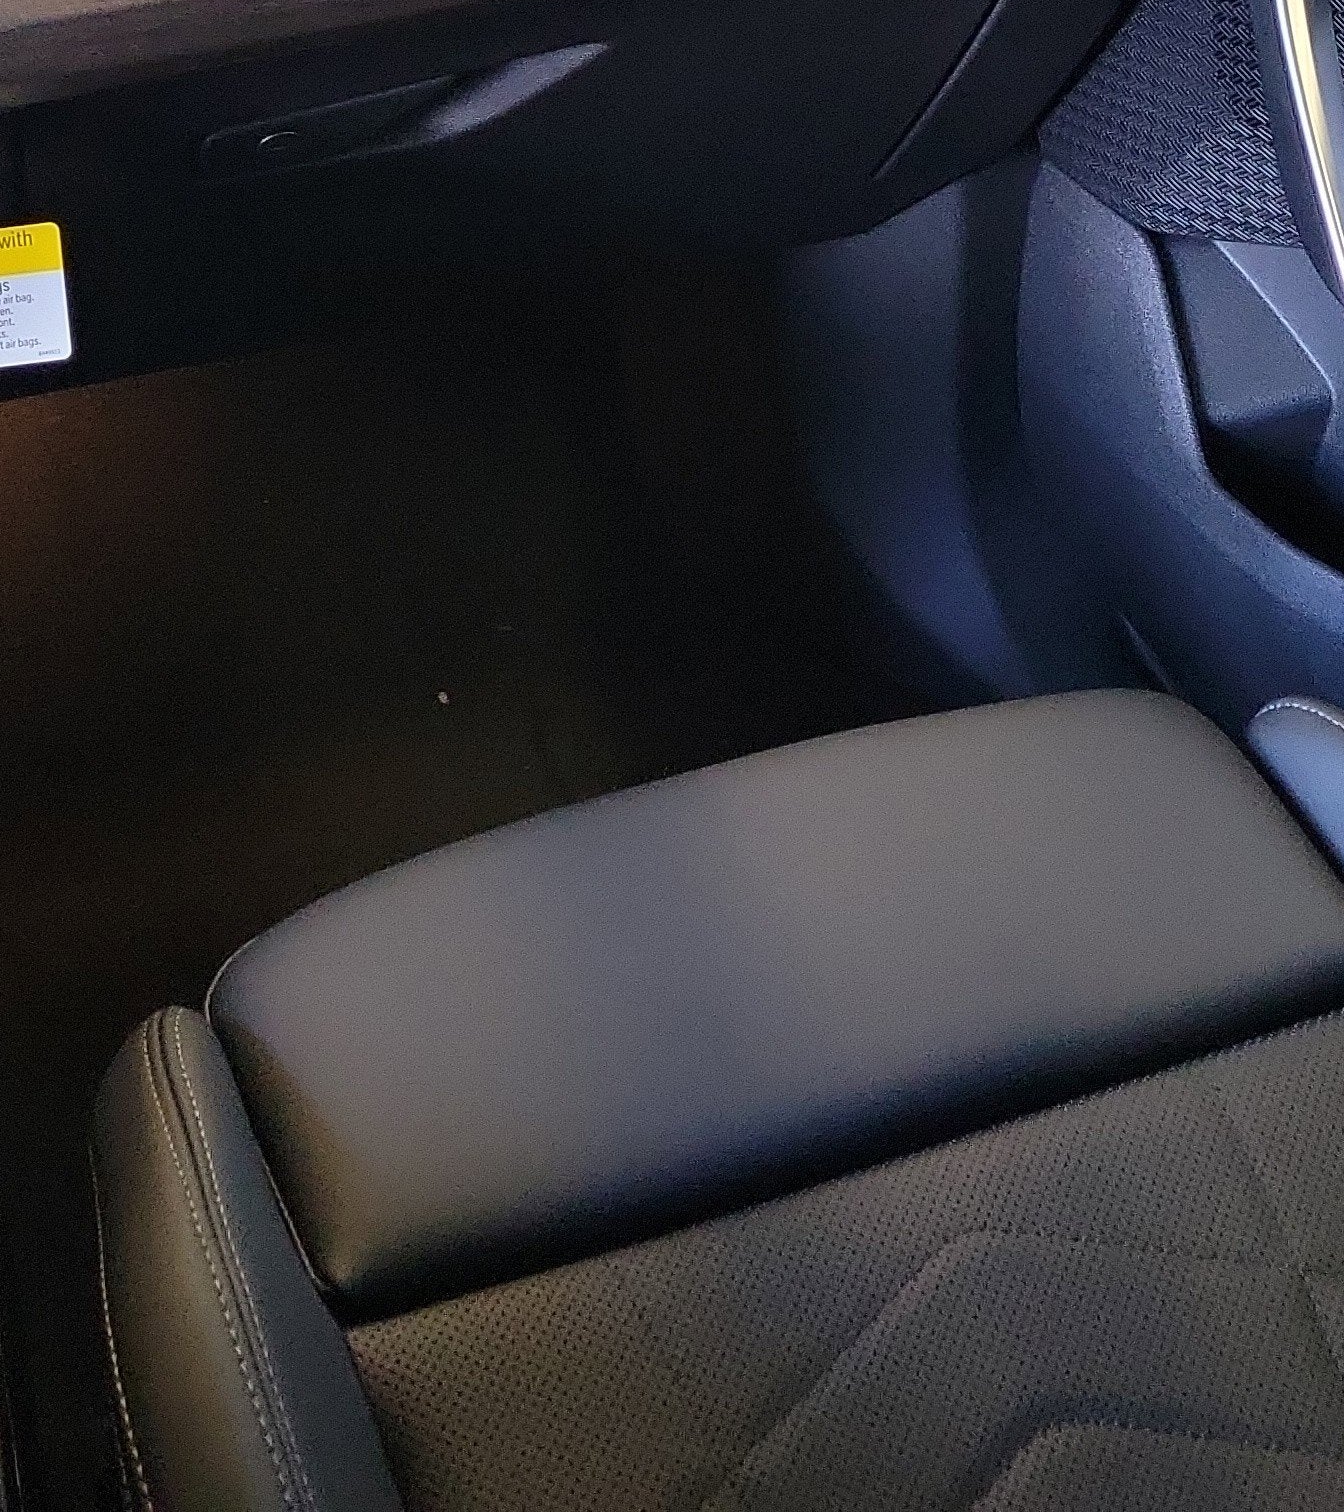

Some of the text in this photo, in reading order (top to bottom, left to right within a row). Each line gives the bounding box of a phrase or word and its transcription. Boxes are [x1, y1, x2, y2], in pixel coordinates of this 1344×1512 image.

[2, 295, 14, 304] air
[15, 293, 34, 305] bag.
[5, 338, 17, 348] air
[17, 336, 41, 349] bags.
